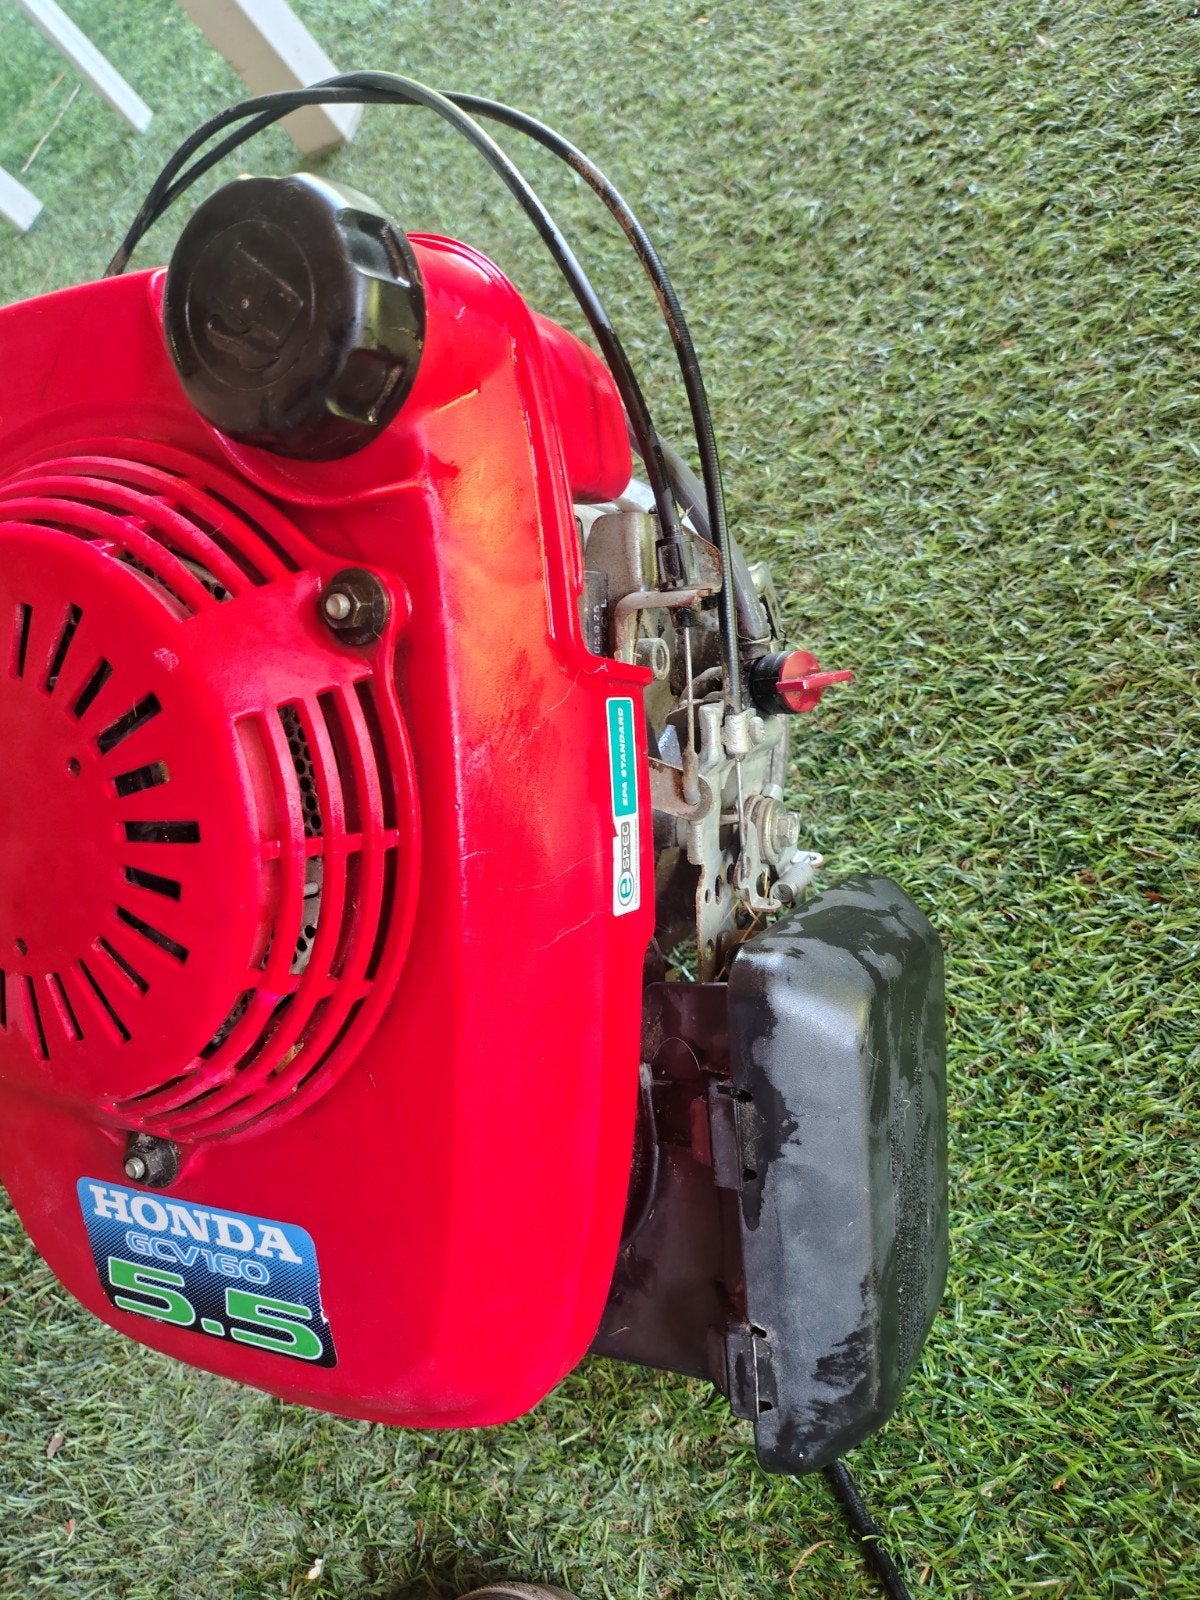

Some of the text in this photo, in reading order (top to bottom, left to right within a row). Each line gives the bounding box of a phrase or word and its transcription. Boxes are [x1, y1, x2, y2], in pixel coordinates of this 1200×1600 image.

[617, 707, 628, 778] STANDARD
[621, 823, 631, 870] SPEC
[89, 1184, 302, 1264] HONDA
[126, 1231, 269, 1284] GCV160
[108, 1256, 322, 1360] 5.5
